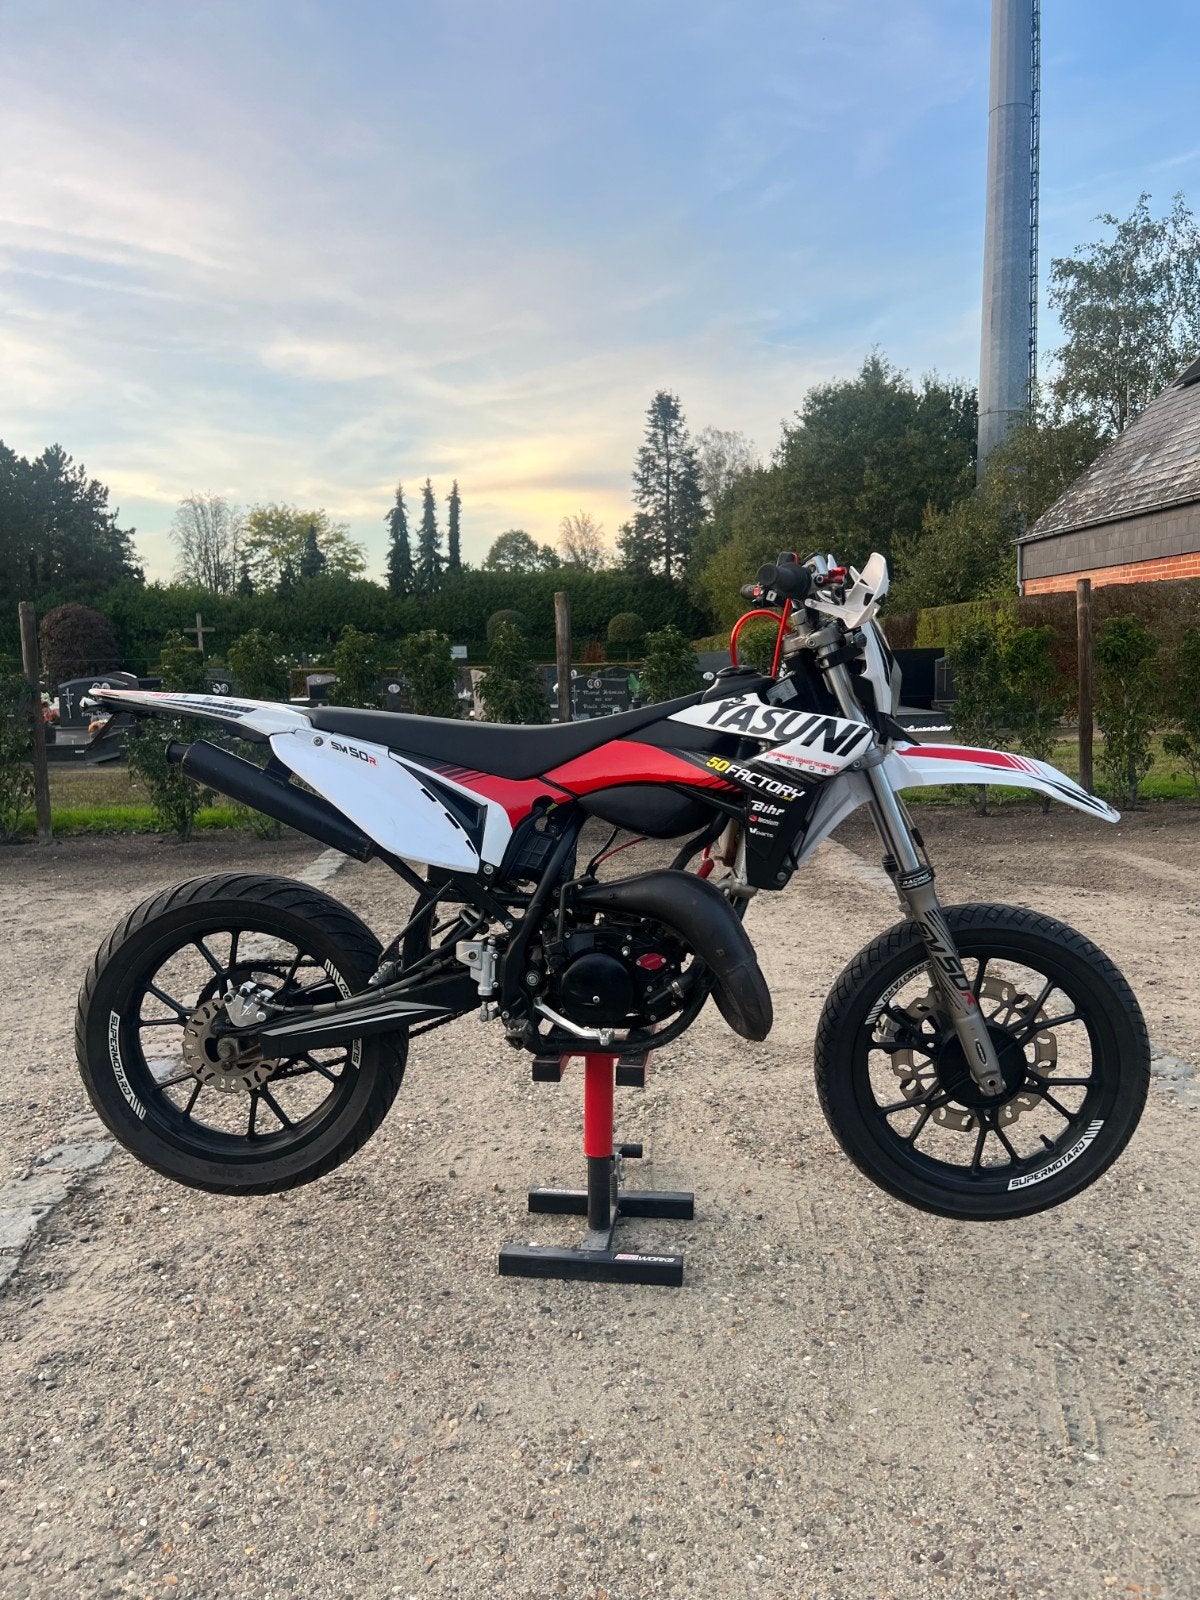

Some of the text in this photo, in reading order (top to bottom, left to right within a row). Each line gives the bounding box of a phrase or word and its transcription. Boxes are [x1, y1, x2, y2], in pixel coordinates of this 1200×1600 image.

[706, 701, 871, 757] YASUNI
[750, 799, 786, 816] Bihr
[109, 1014, 132, 1096] SUPERMOTARD
[1010, 1139, 1087, 1189] SUPERMOTARD
